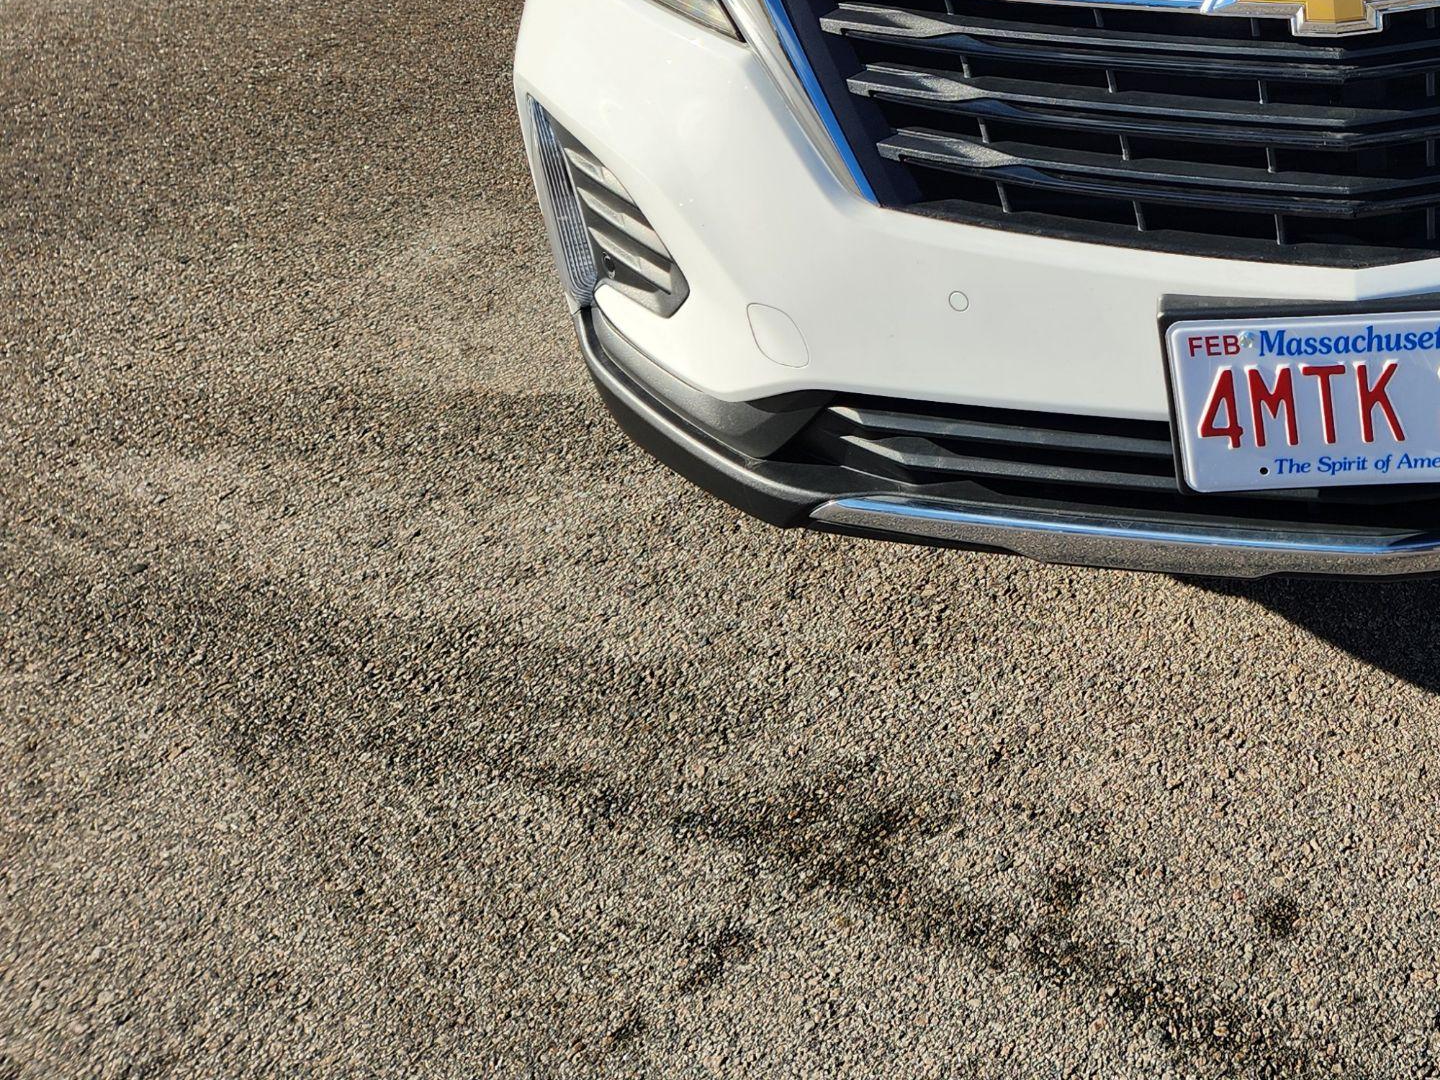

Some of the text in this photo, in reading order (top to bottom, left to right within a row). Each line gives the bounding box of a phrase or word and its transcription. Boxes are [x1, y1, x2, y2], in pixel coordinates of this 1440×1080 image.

[1188, 334, 1241, 358] FEB
[1198, 361, 1406, 449] 4MTK
[1274, 457, 1311, 475] The
[1317, 455, 1368, 477] Spirit
[1374, 453, 1391, 472] of
